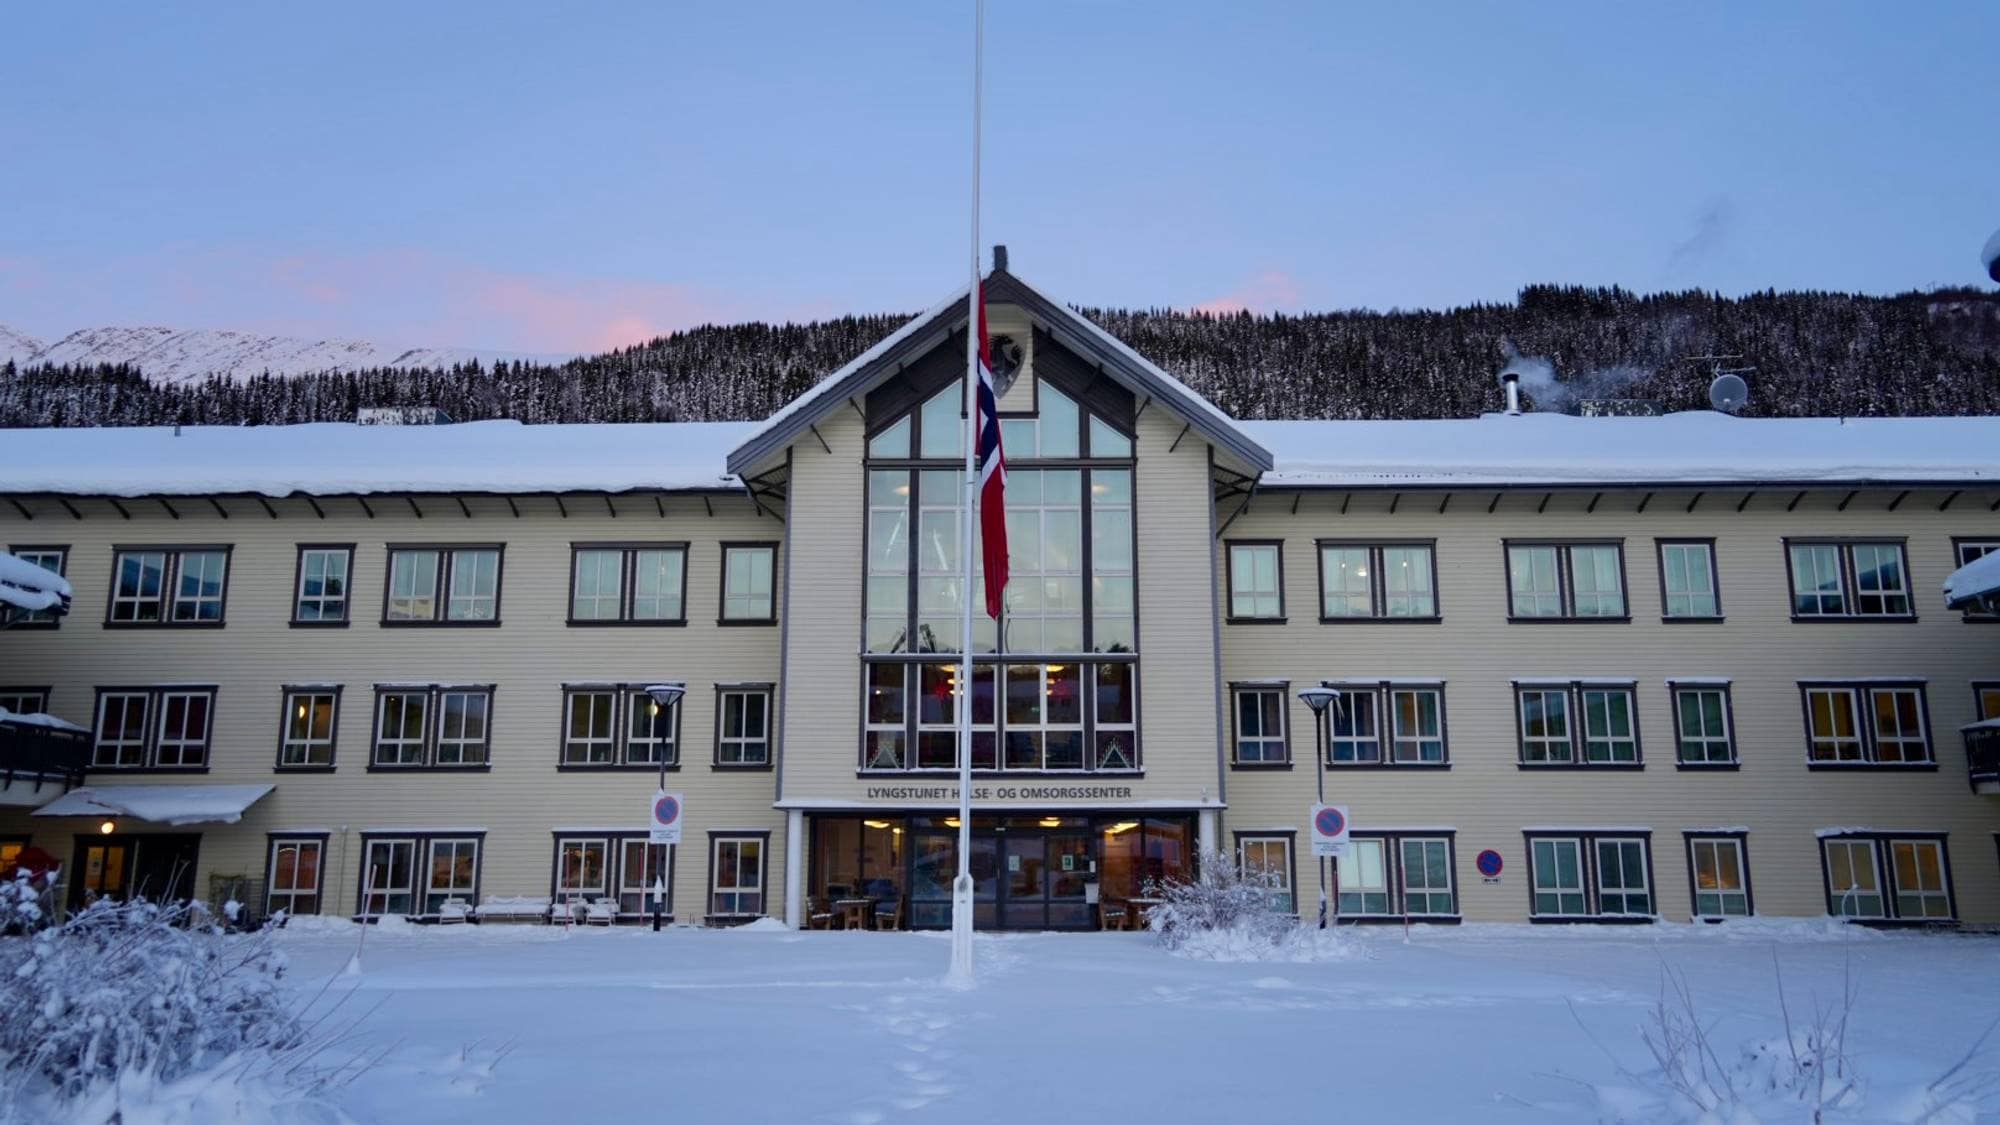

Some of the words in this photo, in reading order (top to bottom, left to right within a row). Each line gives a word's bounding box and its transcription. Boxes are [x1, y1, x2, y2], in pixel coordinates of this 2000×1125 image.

[867, 787, 948, 799] LYNGSTUNET
[996, 787, 1017, 799] OG
[1019, 787, 1132, 799] OMSORGSSENTER
